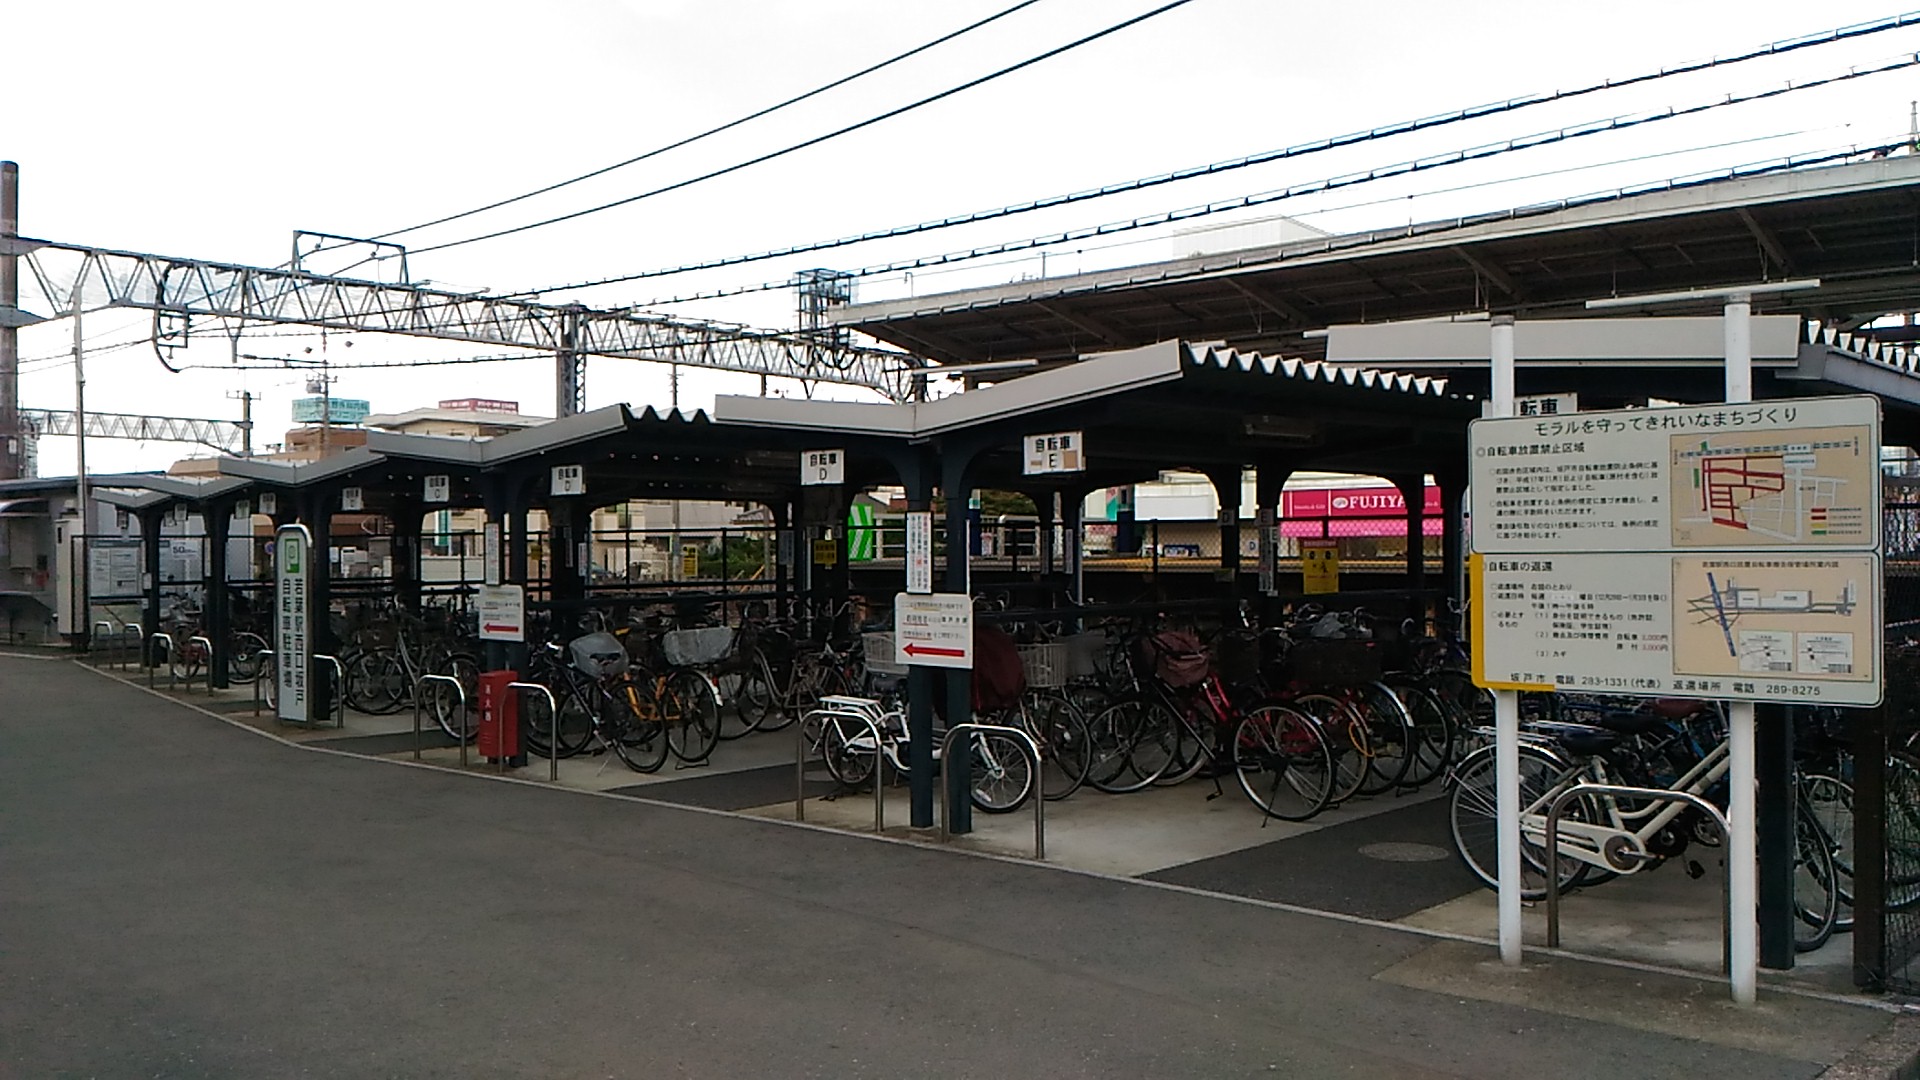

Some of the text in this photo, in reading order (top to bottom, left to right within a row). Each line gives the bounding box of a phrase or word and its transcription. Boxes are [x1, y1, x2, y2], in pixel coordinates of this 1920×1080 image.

[1513, 398, 1558, 416] 転車
[1534, 407, 1798, 437] モラルを守ってきれいなまちづくり
[1035, 436, 1073, 453] 自転車
[809, 453, 837, 467] 自転車
[1049, 454, 1058, 468] E
[558, 468, 578, 480] 自転車
[819, 468, 828, 480] D
[564, 481, 572, 491] D
[1350, 495, 1407, 509] FUJIYA
[1510, 673, 1546, 683] 坂戸市
[1555, 676, 1576, 685] 電話
[1733, 682, 1755, 694] 電話
[1766, 684, 1821, 696] 289-8275
